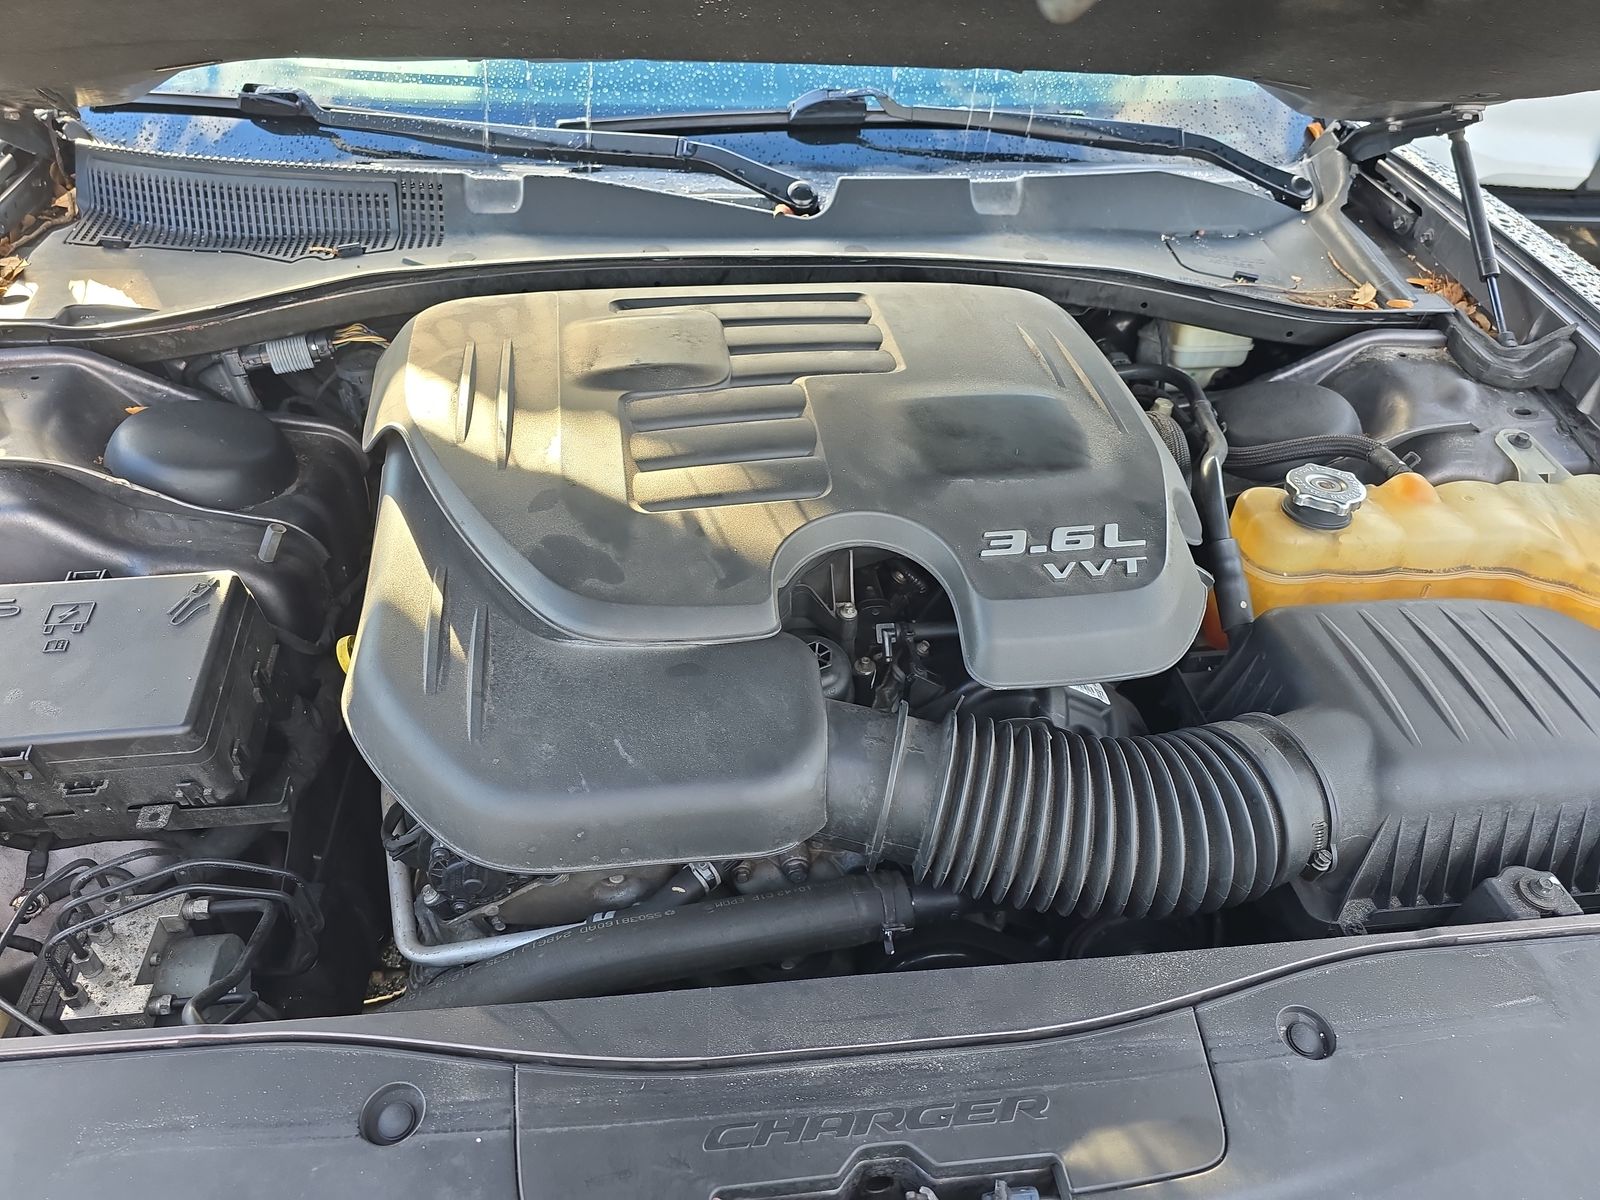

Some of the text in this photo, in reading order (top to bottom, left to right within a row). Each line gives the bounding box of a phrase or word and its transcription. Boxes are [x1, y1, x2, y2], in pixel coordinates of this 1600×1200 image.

[980, 522, 1147, 558] 3.6L
[1043, 556, 1148, 581] VVT
[702, 1095, 1050, 1152] CHARGER
